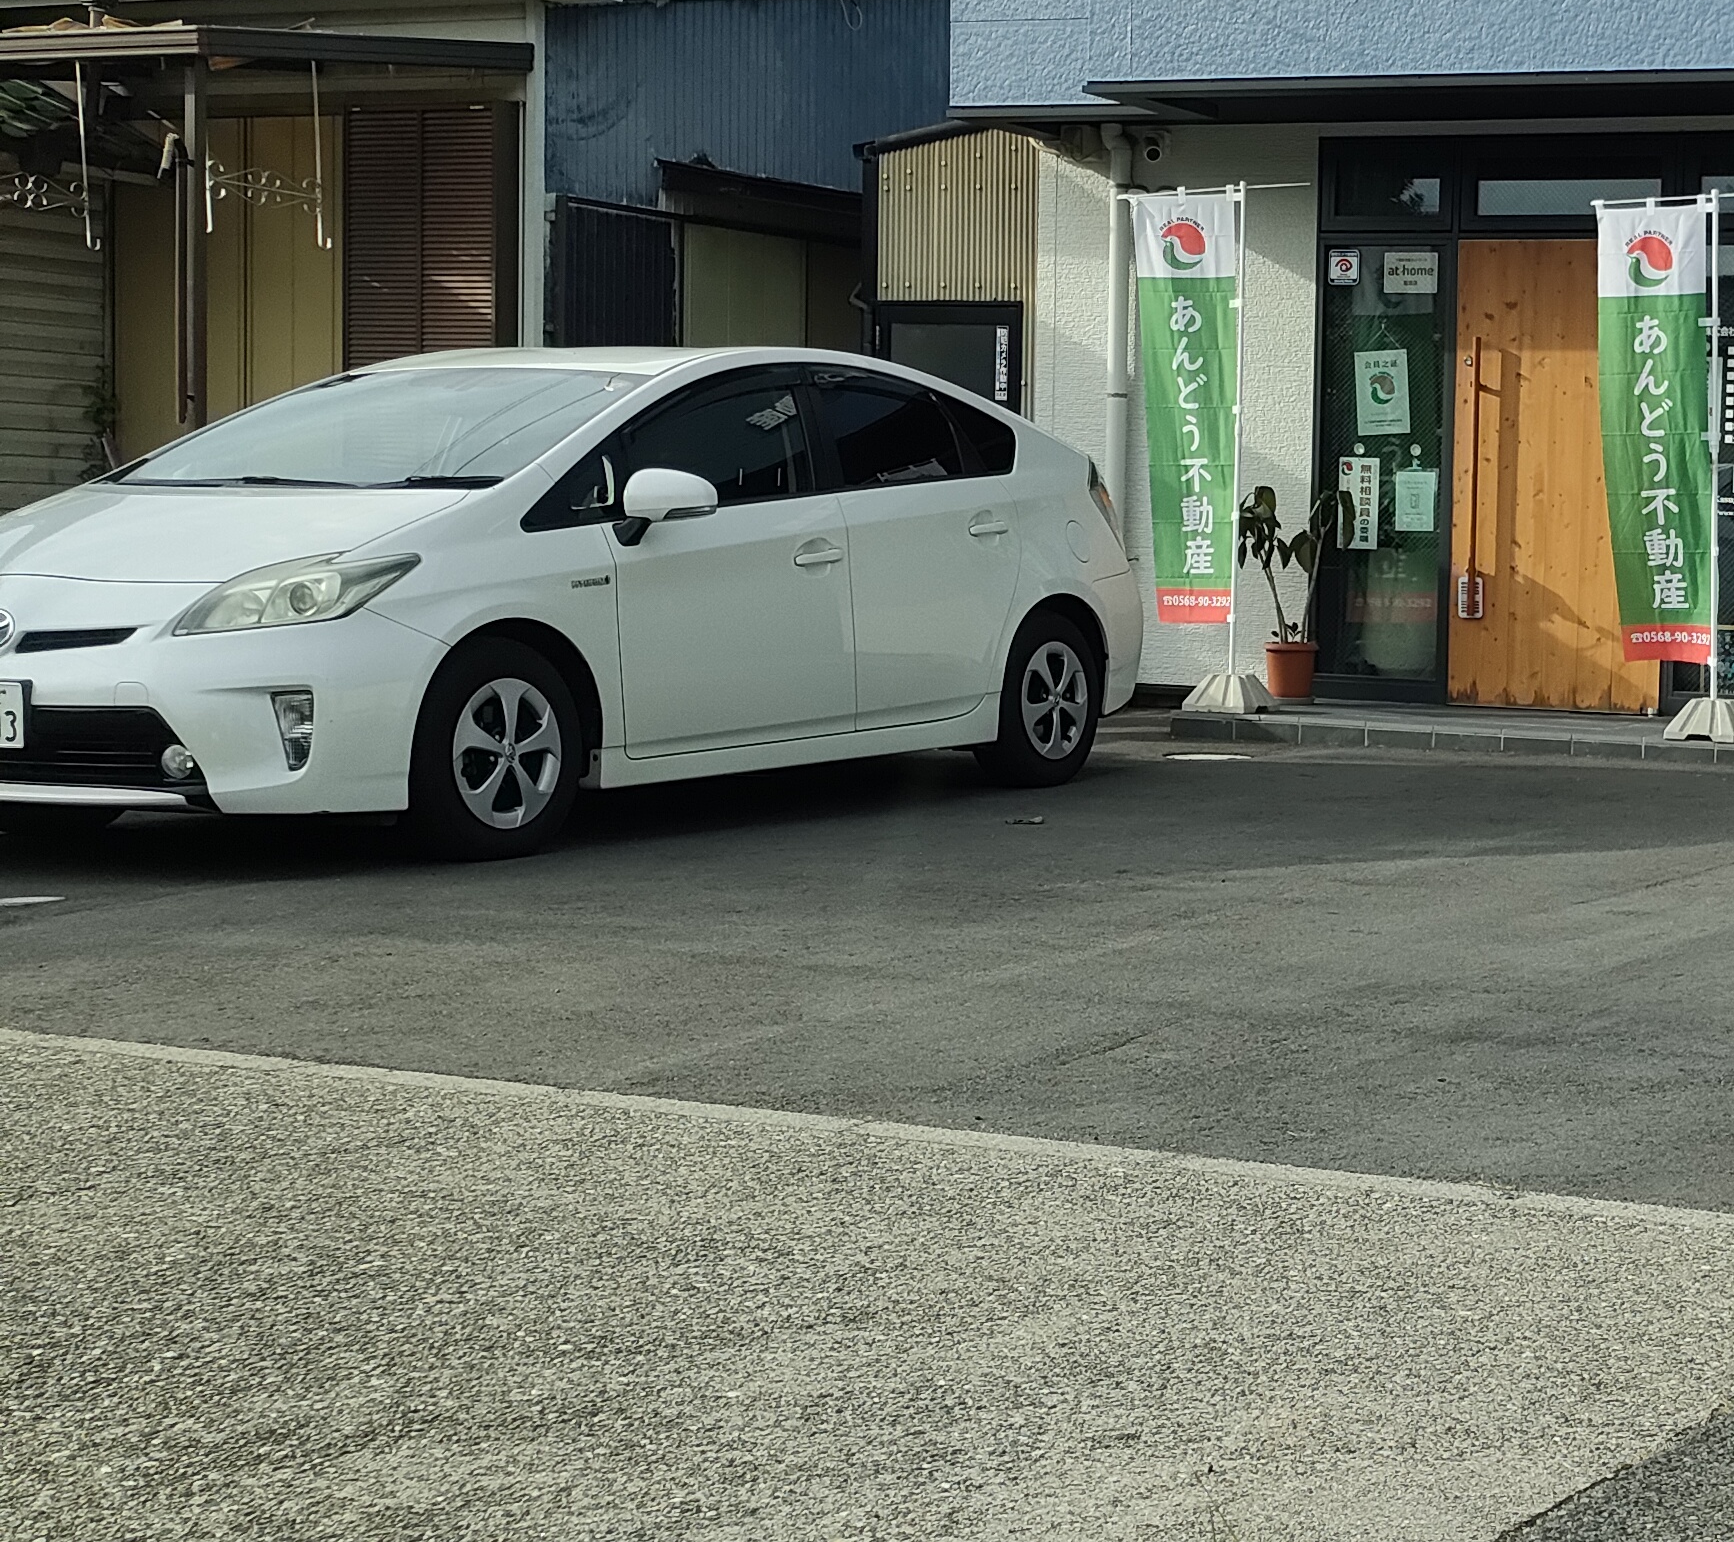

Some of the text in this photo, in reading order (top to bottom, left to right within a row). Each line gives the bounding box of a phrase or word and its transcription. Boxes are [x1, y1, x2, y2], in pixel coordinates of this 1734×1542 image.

[1176, 216, 1205, 232] PARTNER
[1625, 230, 1673, 247] REAL PARTNER
[1401, 264, 1434, 276] home
[1169, 295, 1214, 574] あんどう不動産
[1633, 314, 1690, 609] あんどう不動産
[1173, 594, 1231, 607] 0568-90-3292
